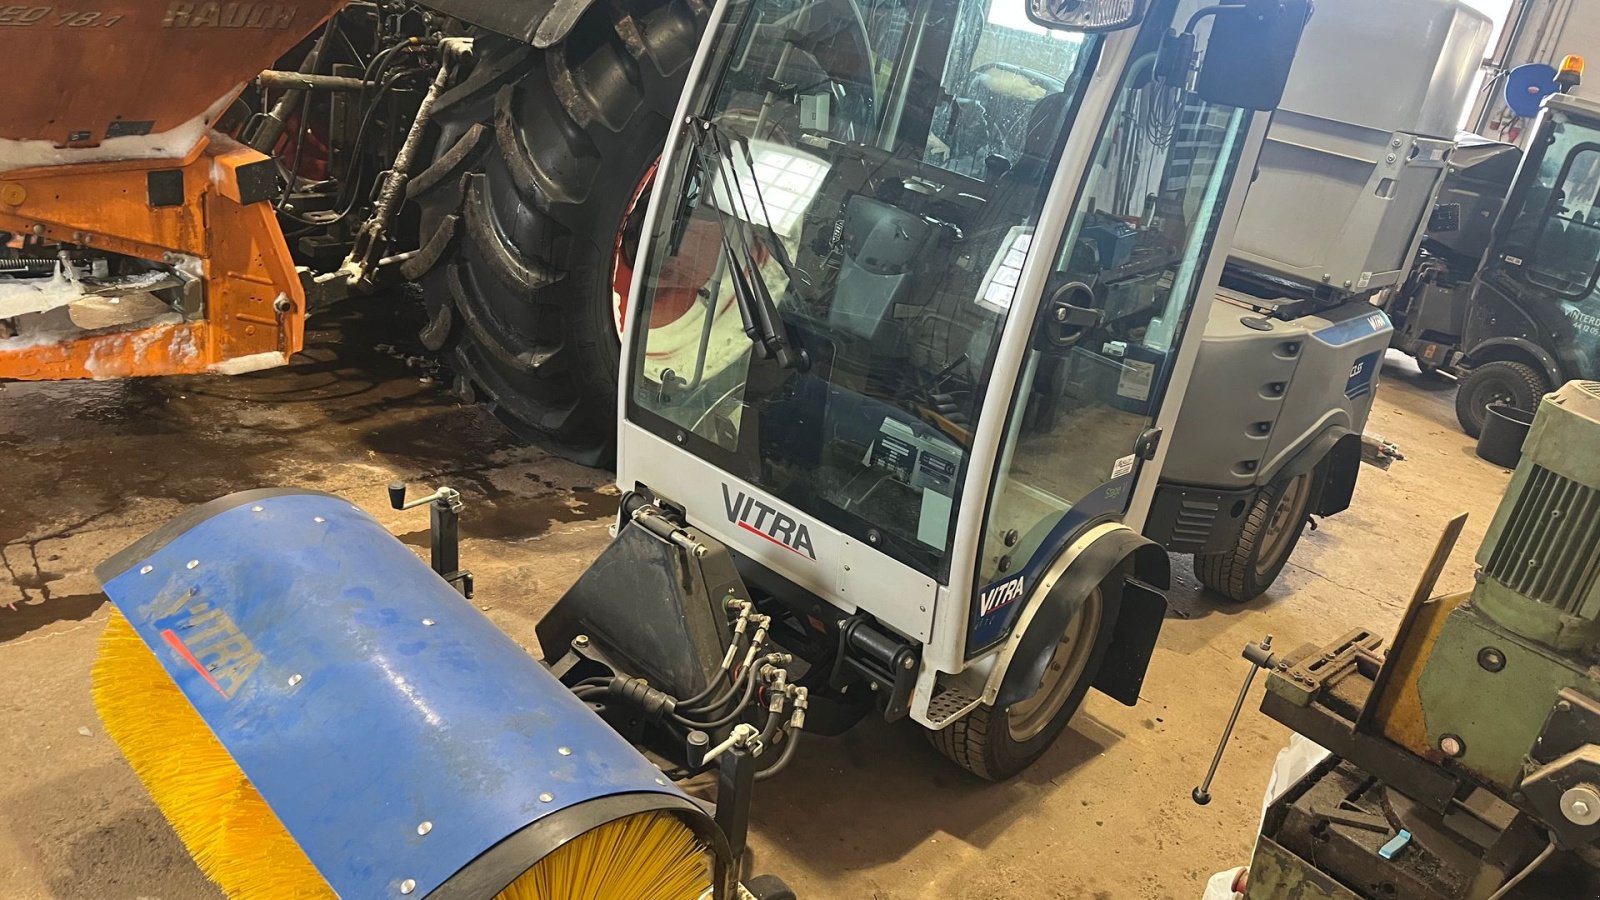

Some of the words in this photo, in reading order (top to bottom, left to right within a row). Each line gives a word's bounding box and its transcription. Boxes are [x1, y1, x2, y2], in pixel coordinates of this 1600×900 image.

[162, 2, 300, 30] RAUCH
[721, 481, 817, 561] VITRA
[980, 575, 1024, 618] VITRA
[143, 582, 263, 700] VITRA
